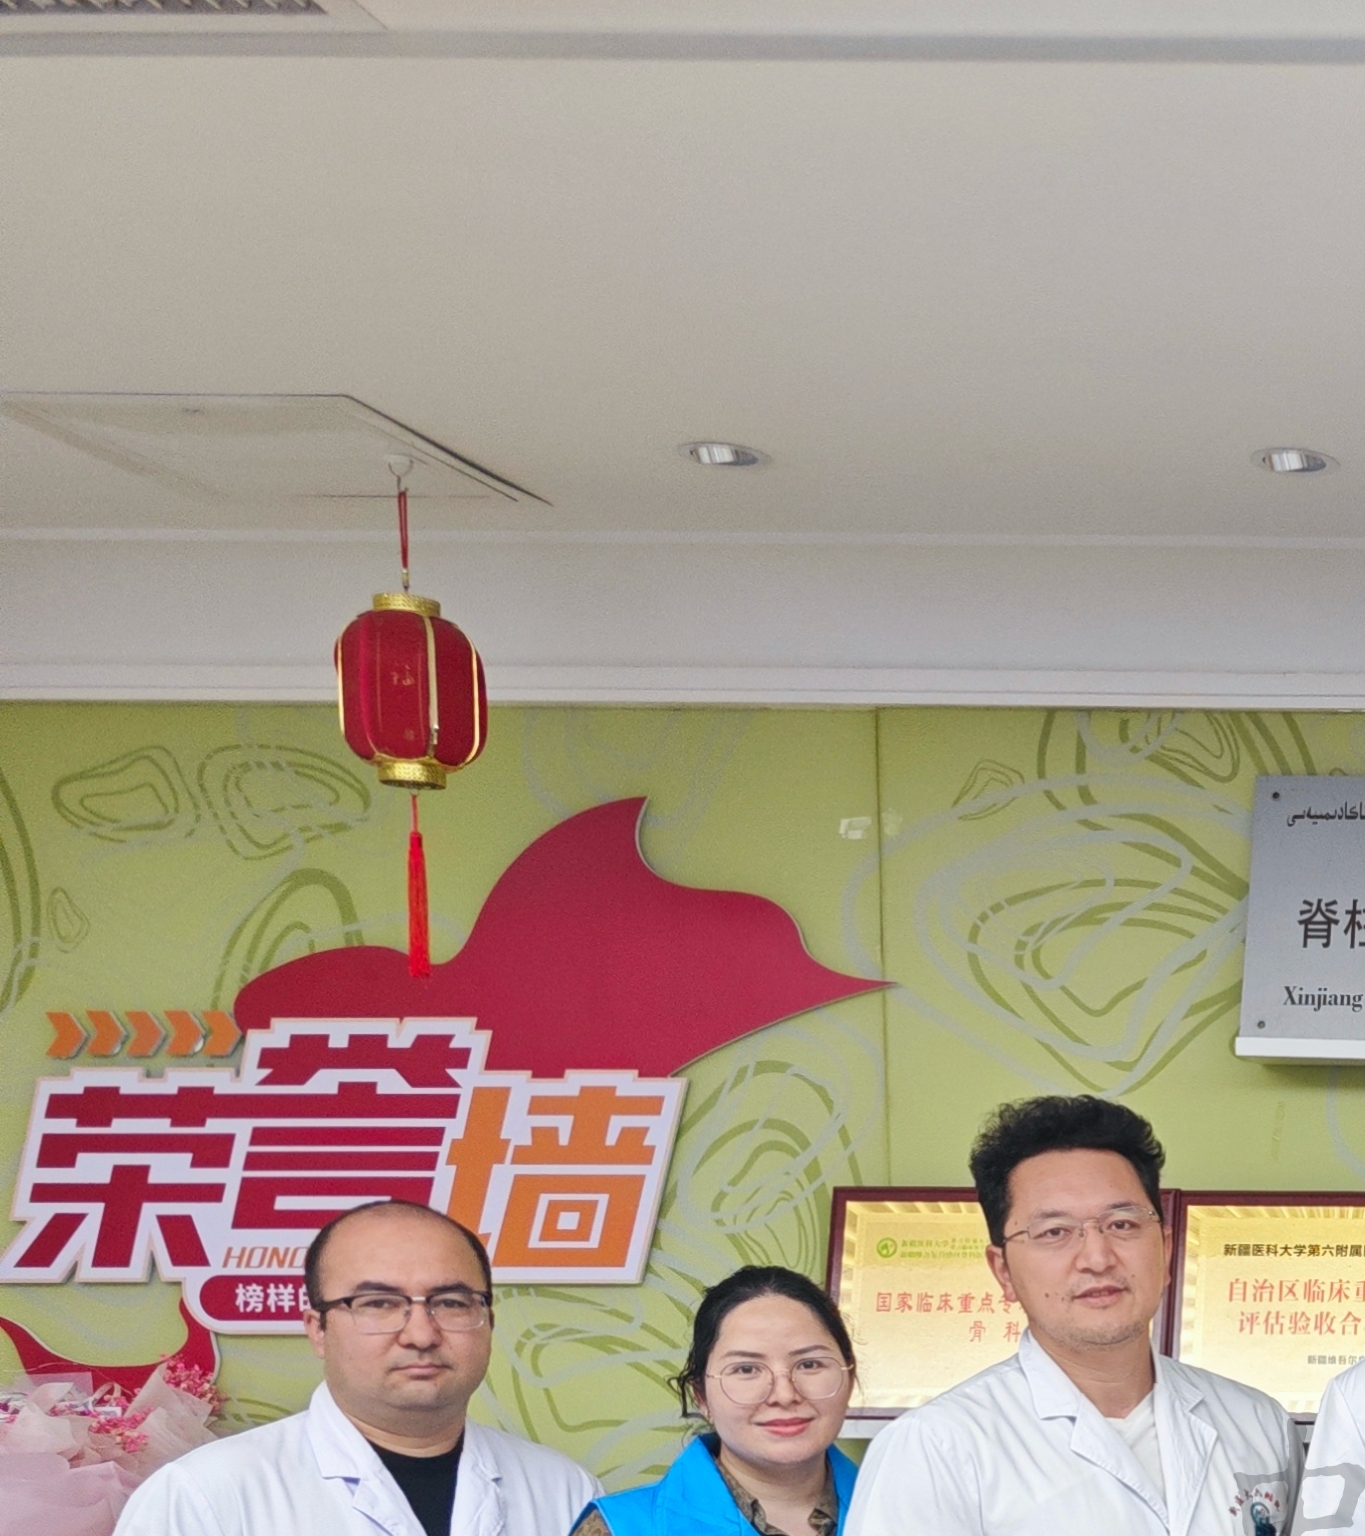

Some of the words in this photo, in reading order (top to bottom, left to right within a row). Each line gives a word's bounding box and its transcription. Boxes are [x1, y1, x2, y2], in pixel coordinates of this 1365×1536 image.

[1283, 985, 1363, 1011] Xinjiang
[14, 1033, 665, 1269] 荣誉墙
[876, 1291, 1023, 1315] 国家临床重点专
